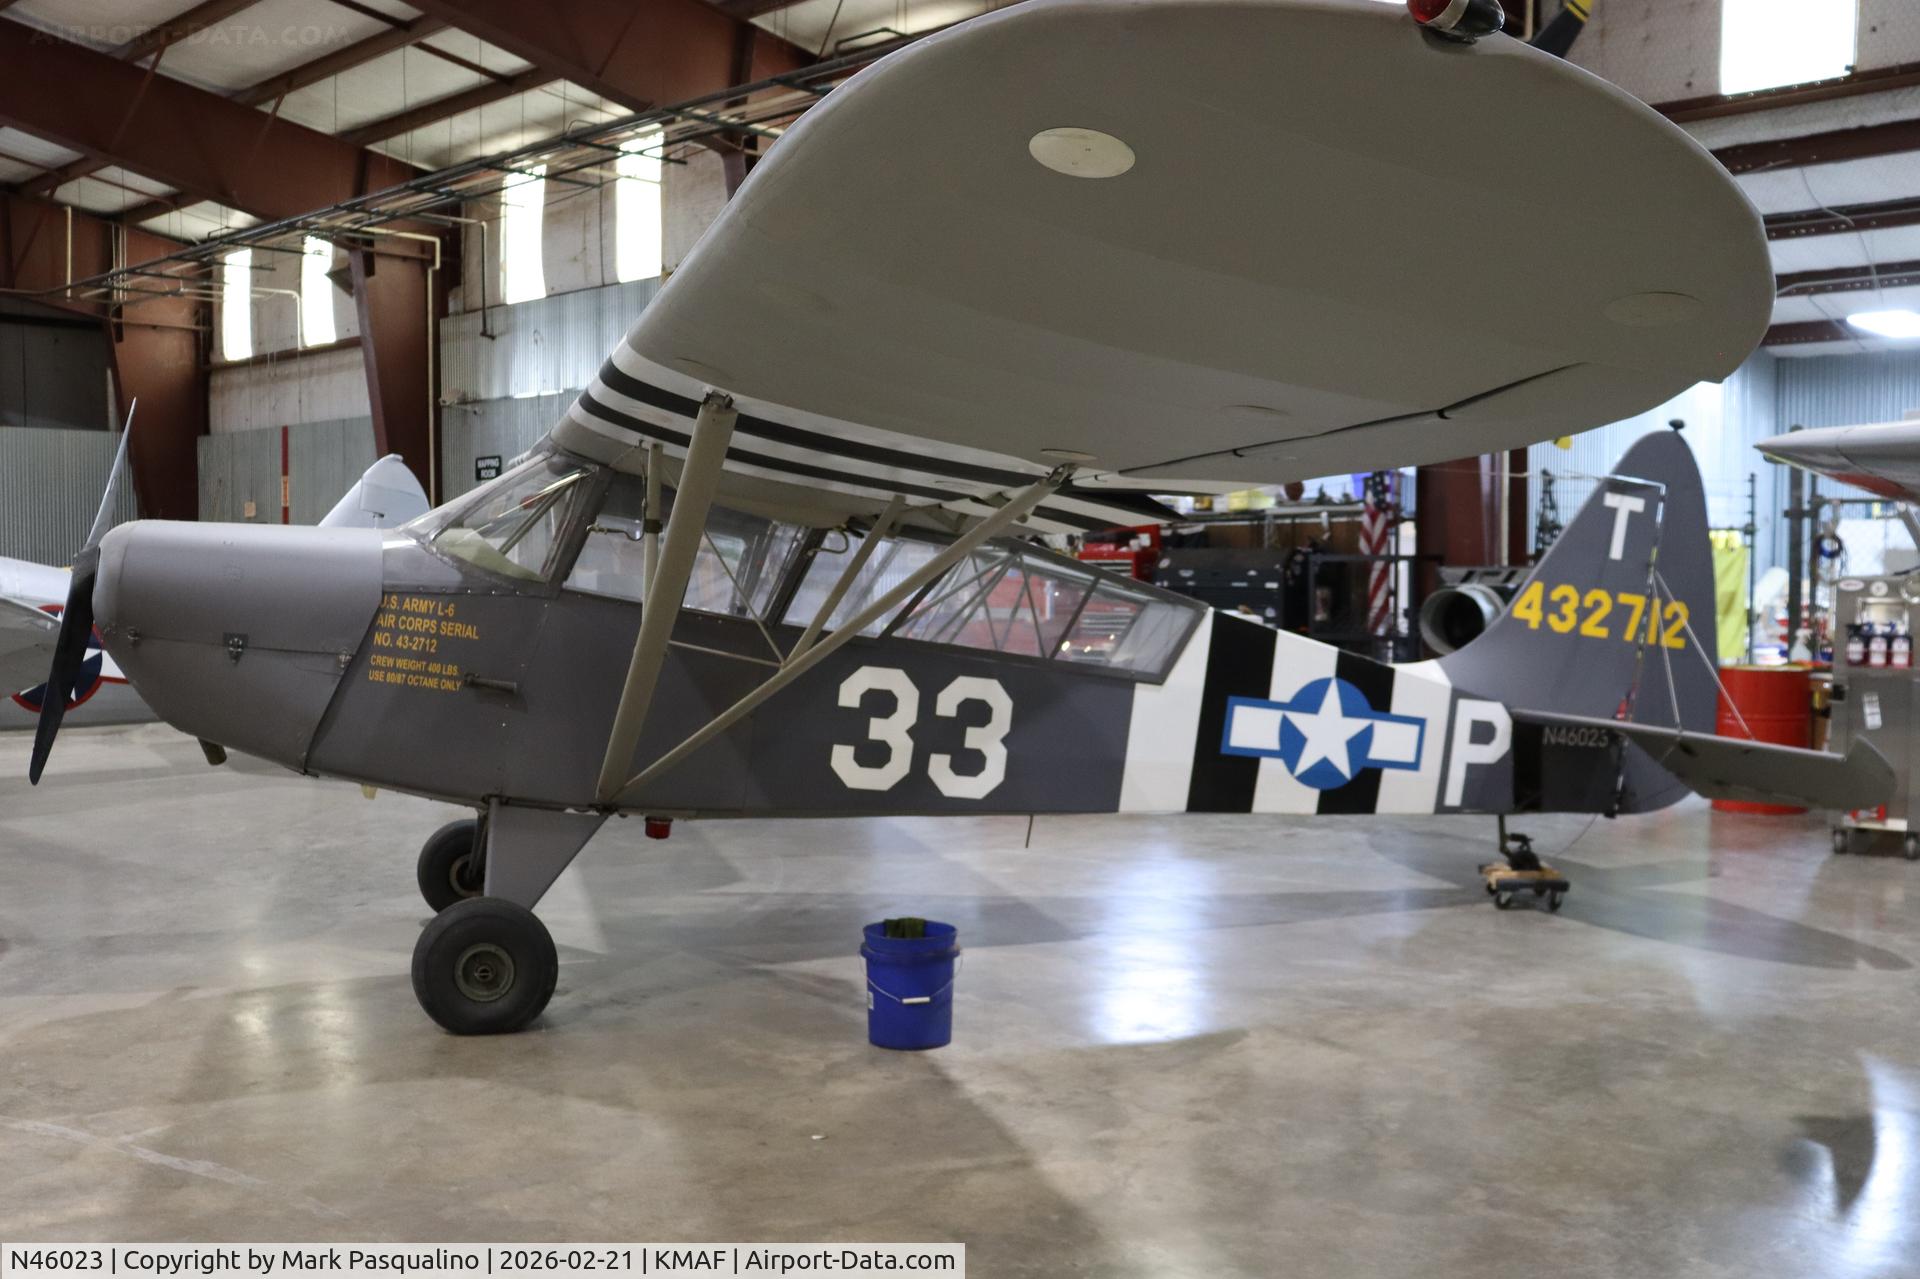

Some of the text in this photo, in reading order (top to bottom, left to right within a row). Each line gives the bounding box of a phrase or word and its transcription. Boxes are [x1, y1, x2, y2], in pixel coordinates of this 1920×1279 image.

[1603, 492, 1646, 561] T
[402, 597, 436, 614] ARMY
[437, 601, 455, 617] L-6
[1511, 580, 1691, 650] 432712
[376, 613, 480, 640] AIR CORPS SERIAL
[373, 631, 438, 653] NO. 43-2712
[370, 654, 395, 668] CREW
[395, 657, 427, 672] WEIGHT
[427, 661, 442, 674] 400
[368, 669, 385, 682] USE
[407, 674, 440, 689] OCTANE
[440, 679, 462, 692] ONLY
[830, 665, 1014, 800] 33
[1444, 698, 1513, 807] P
